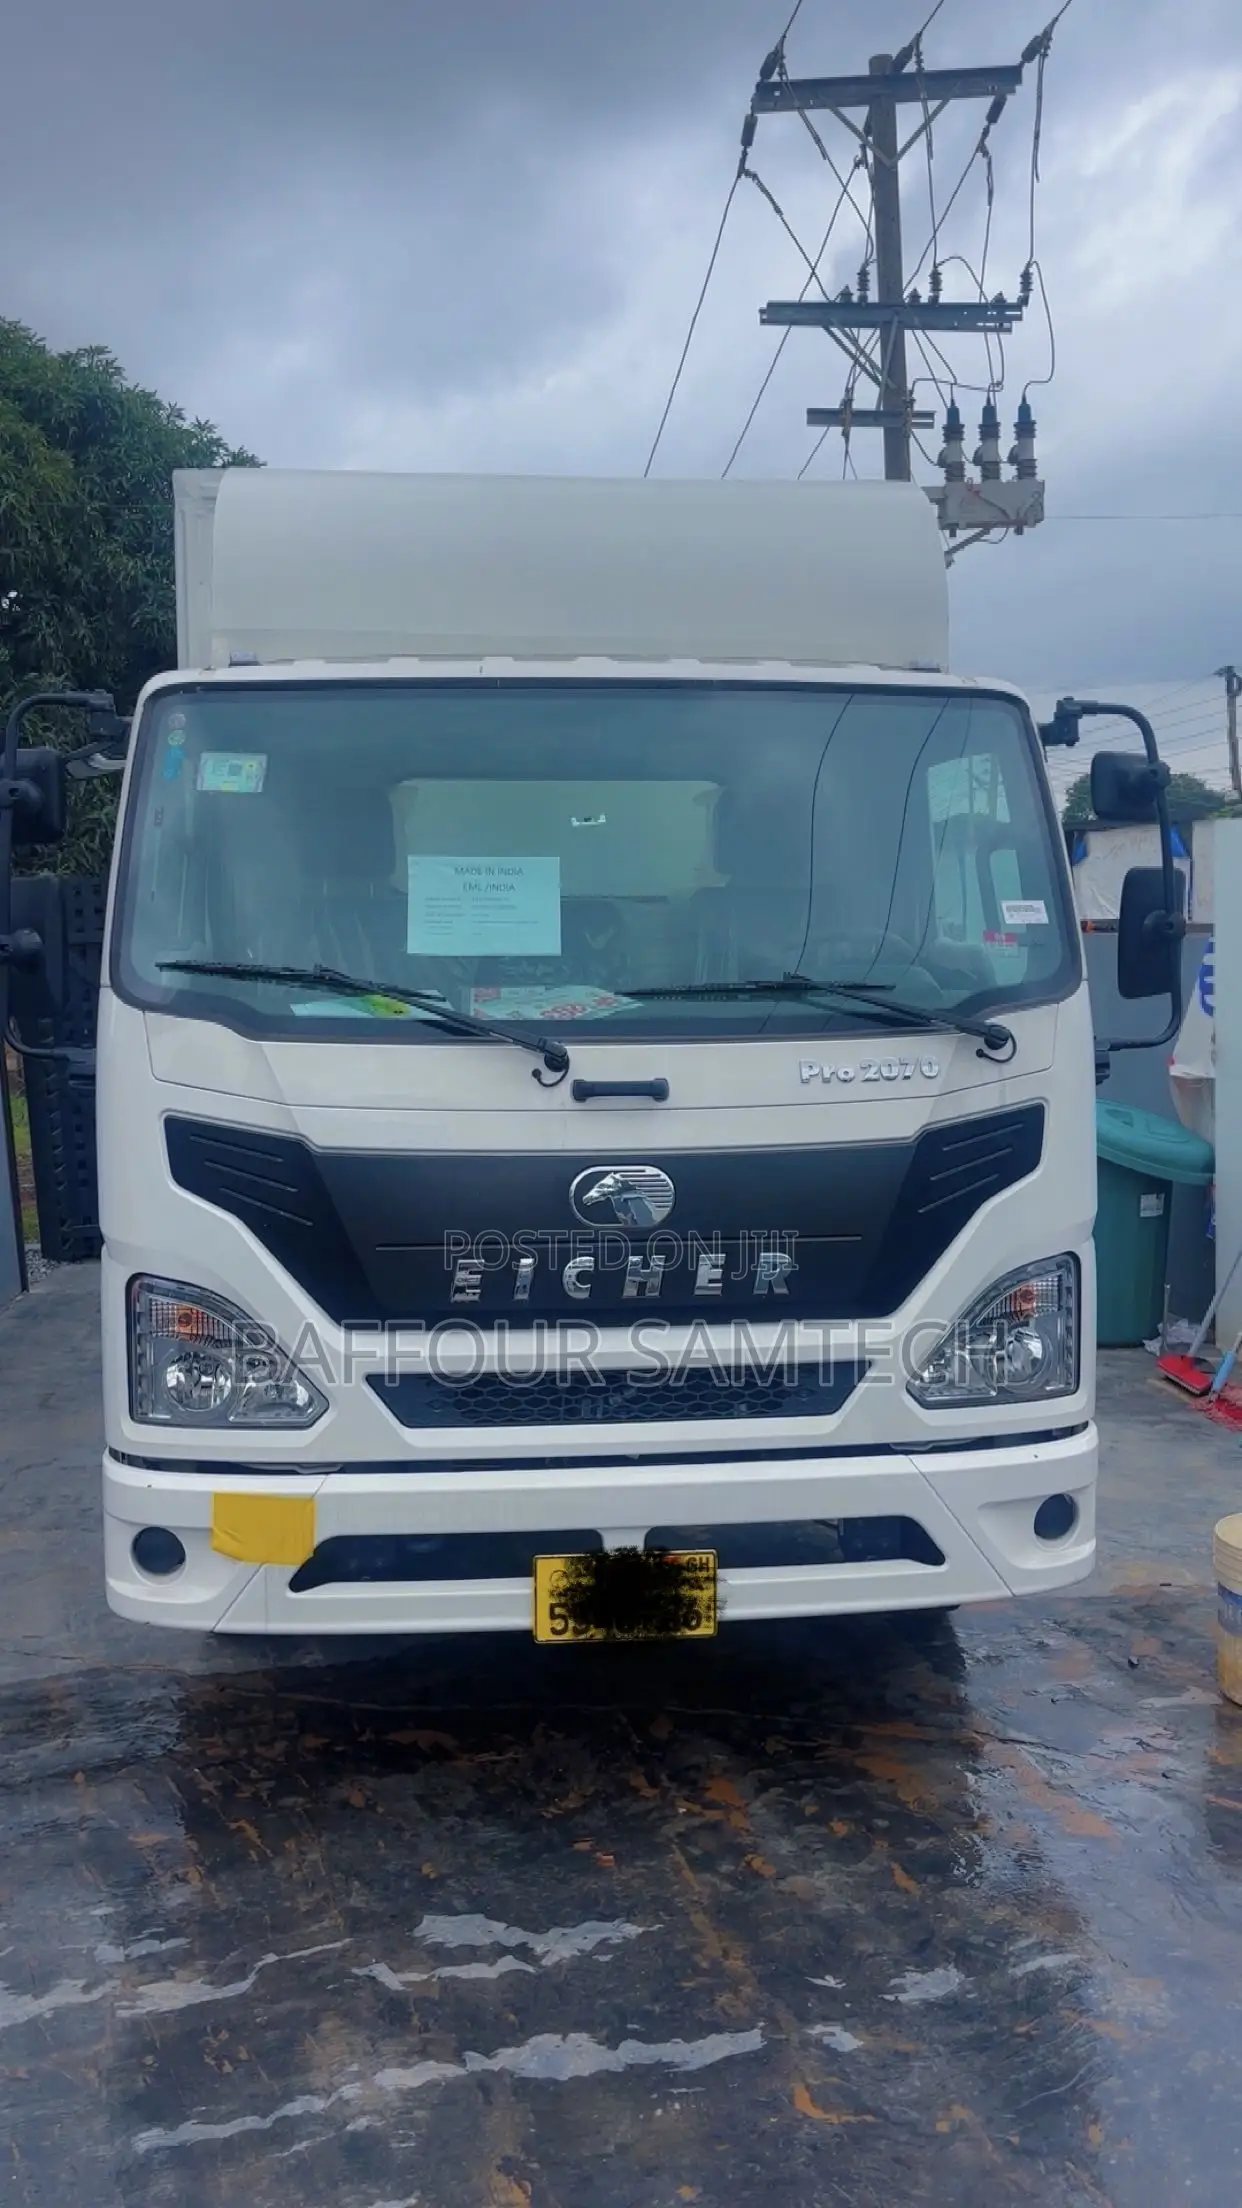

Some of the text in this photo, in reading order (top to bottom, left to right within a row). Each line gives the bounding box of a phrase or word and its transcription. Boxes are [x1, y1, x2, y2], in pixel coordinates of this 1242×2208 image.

[454, 866, 525, 877] MADE IN INDIA
[799, 1056, 940, 1084] Pro 2070
[450, 1252, 792, 1302] EICHER
